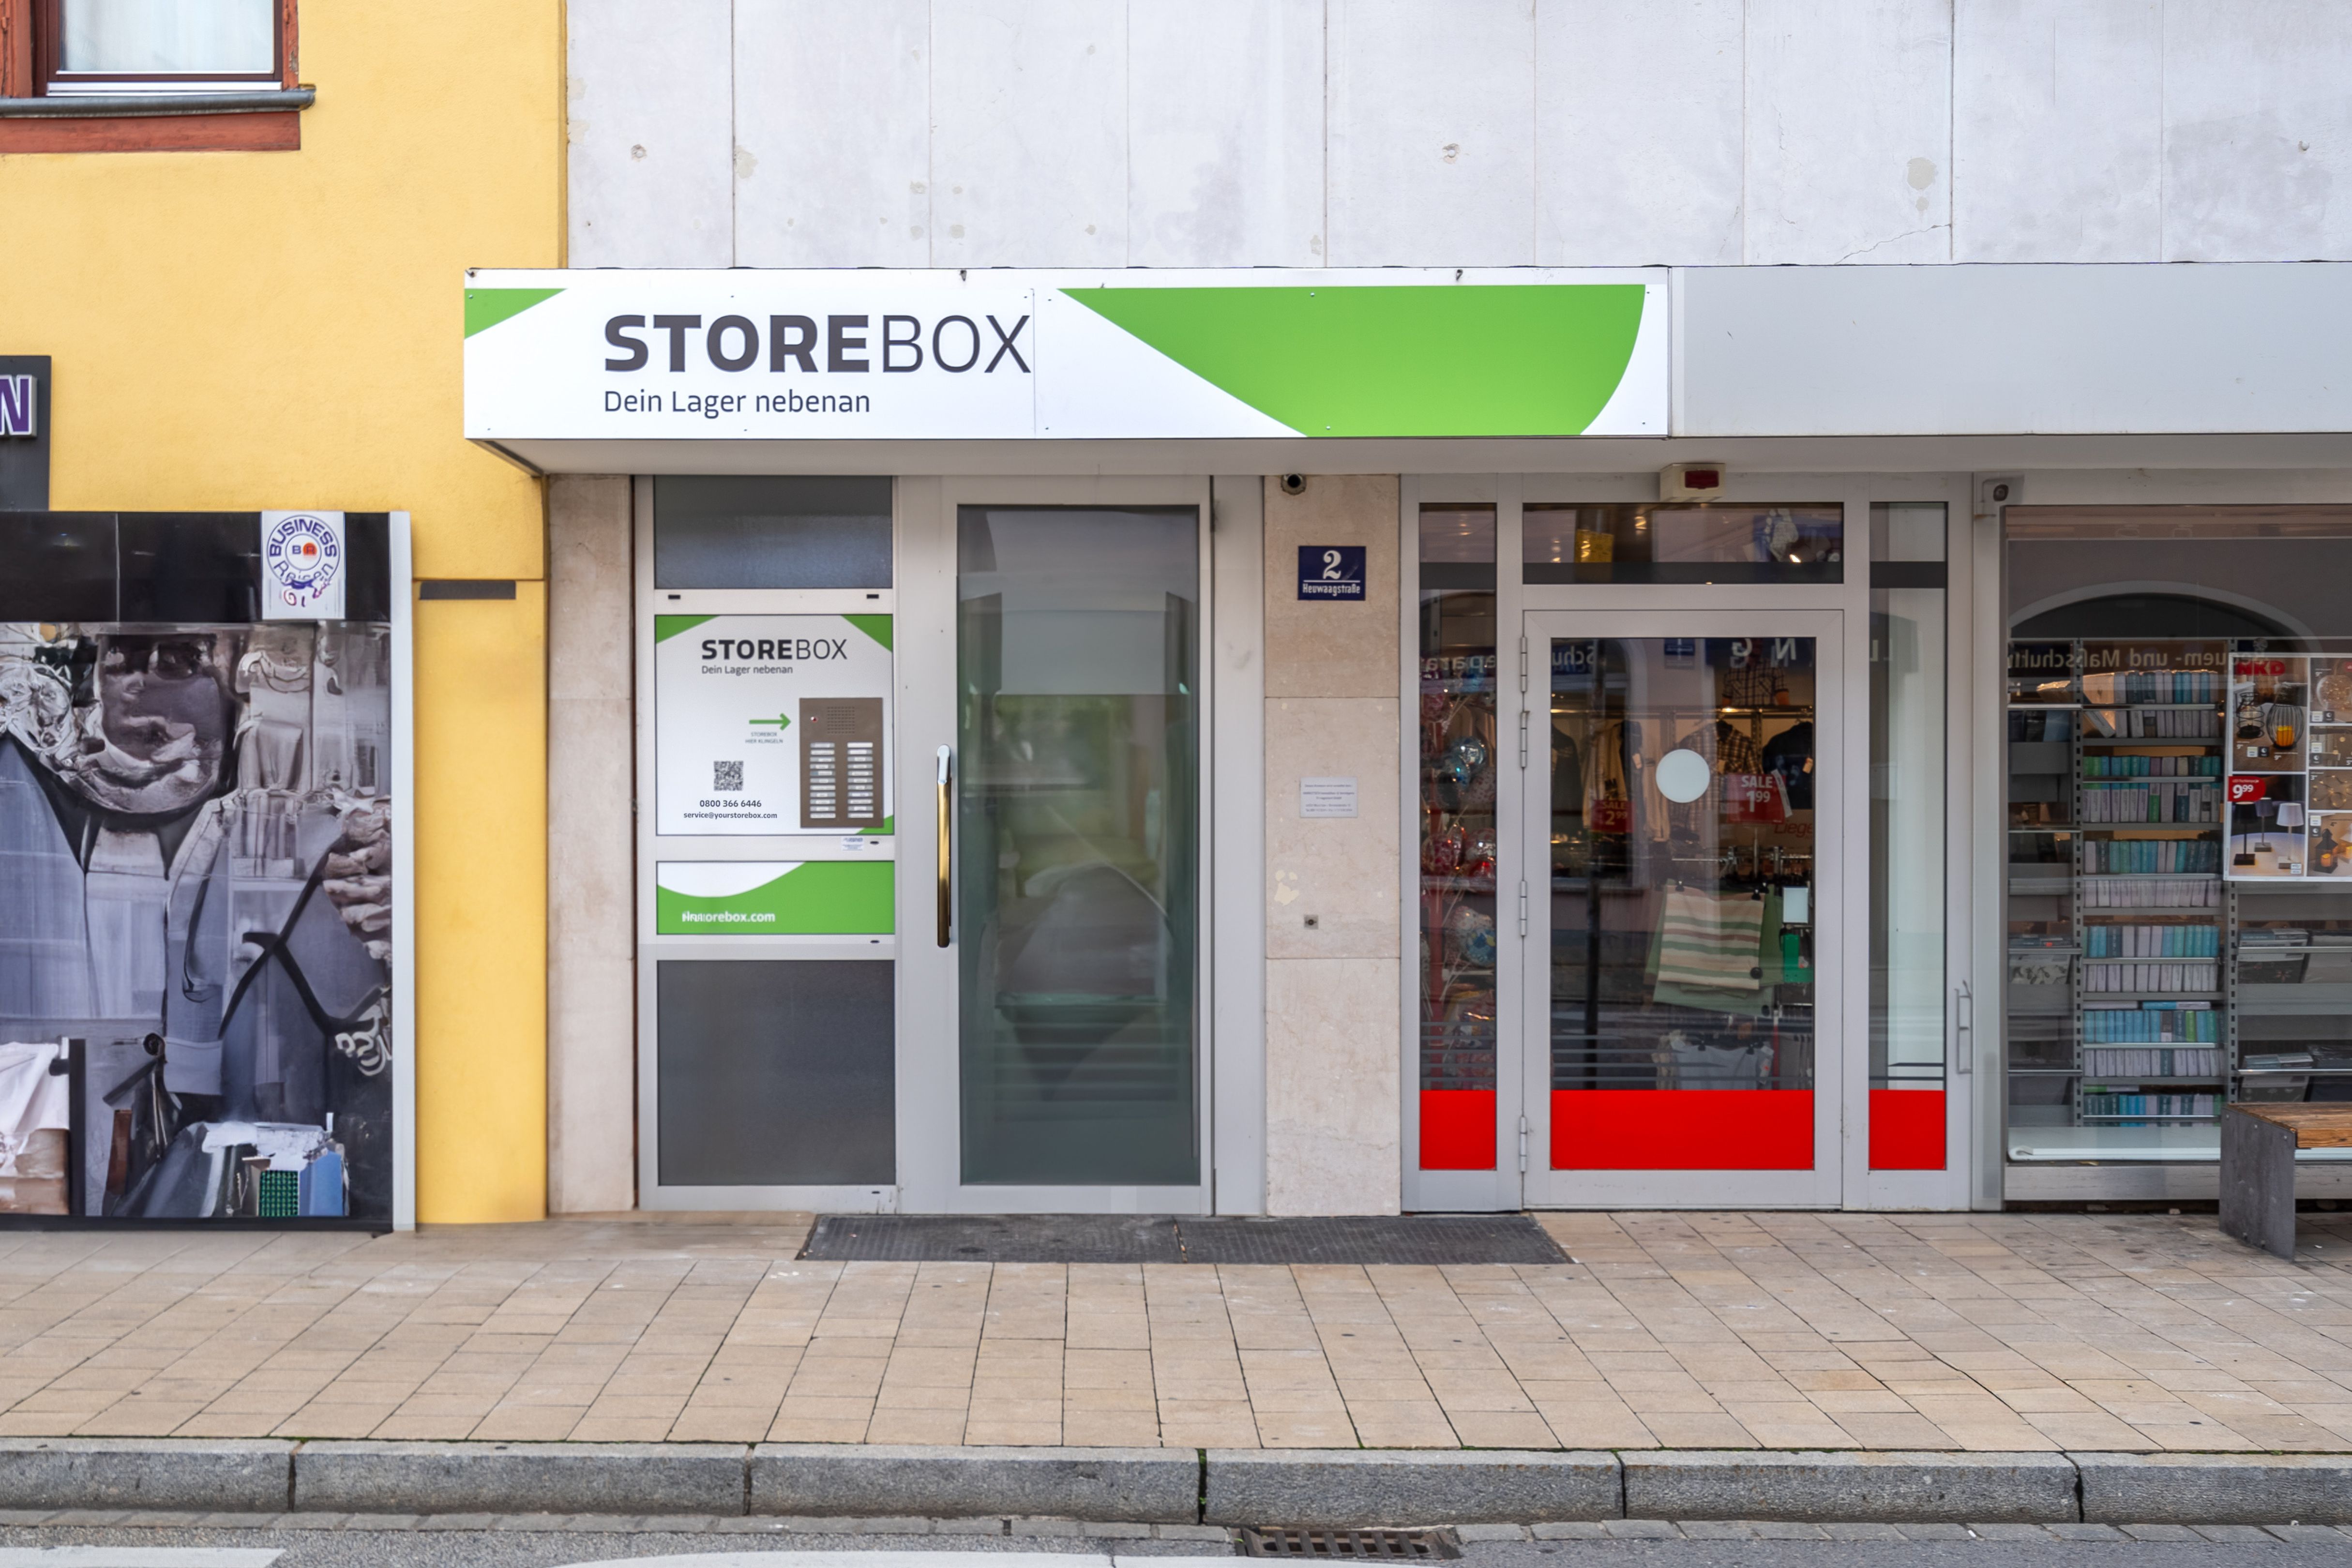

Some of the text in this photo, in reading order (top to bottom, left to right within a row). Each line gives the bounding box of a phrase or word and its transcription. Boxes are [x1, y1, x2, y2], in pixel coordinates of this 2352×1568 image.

[604, 314, 1031, 374] STOREBOX
[604, 389, 870, 420] Dein Lager nebenan
[269, 519, 337, 558] BUSINESS
[1323, 550, 1342, 579] 2
[1302, 583, 1361, 597] Heuwaagstraße
[701, 639, 848, 660] STOREBOX
[702, 664, 793, 677] Dein Lager nebenan
[2235, 660, 2286, 676] NKD
[1741, 775, 1773, 788] SALE
[683, 812, 778, 820] service@yourstorebox.com
